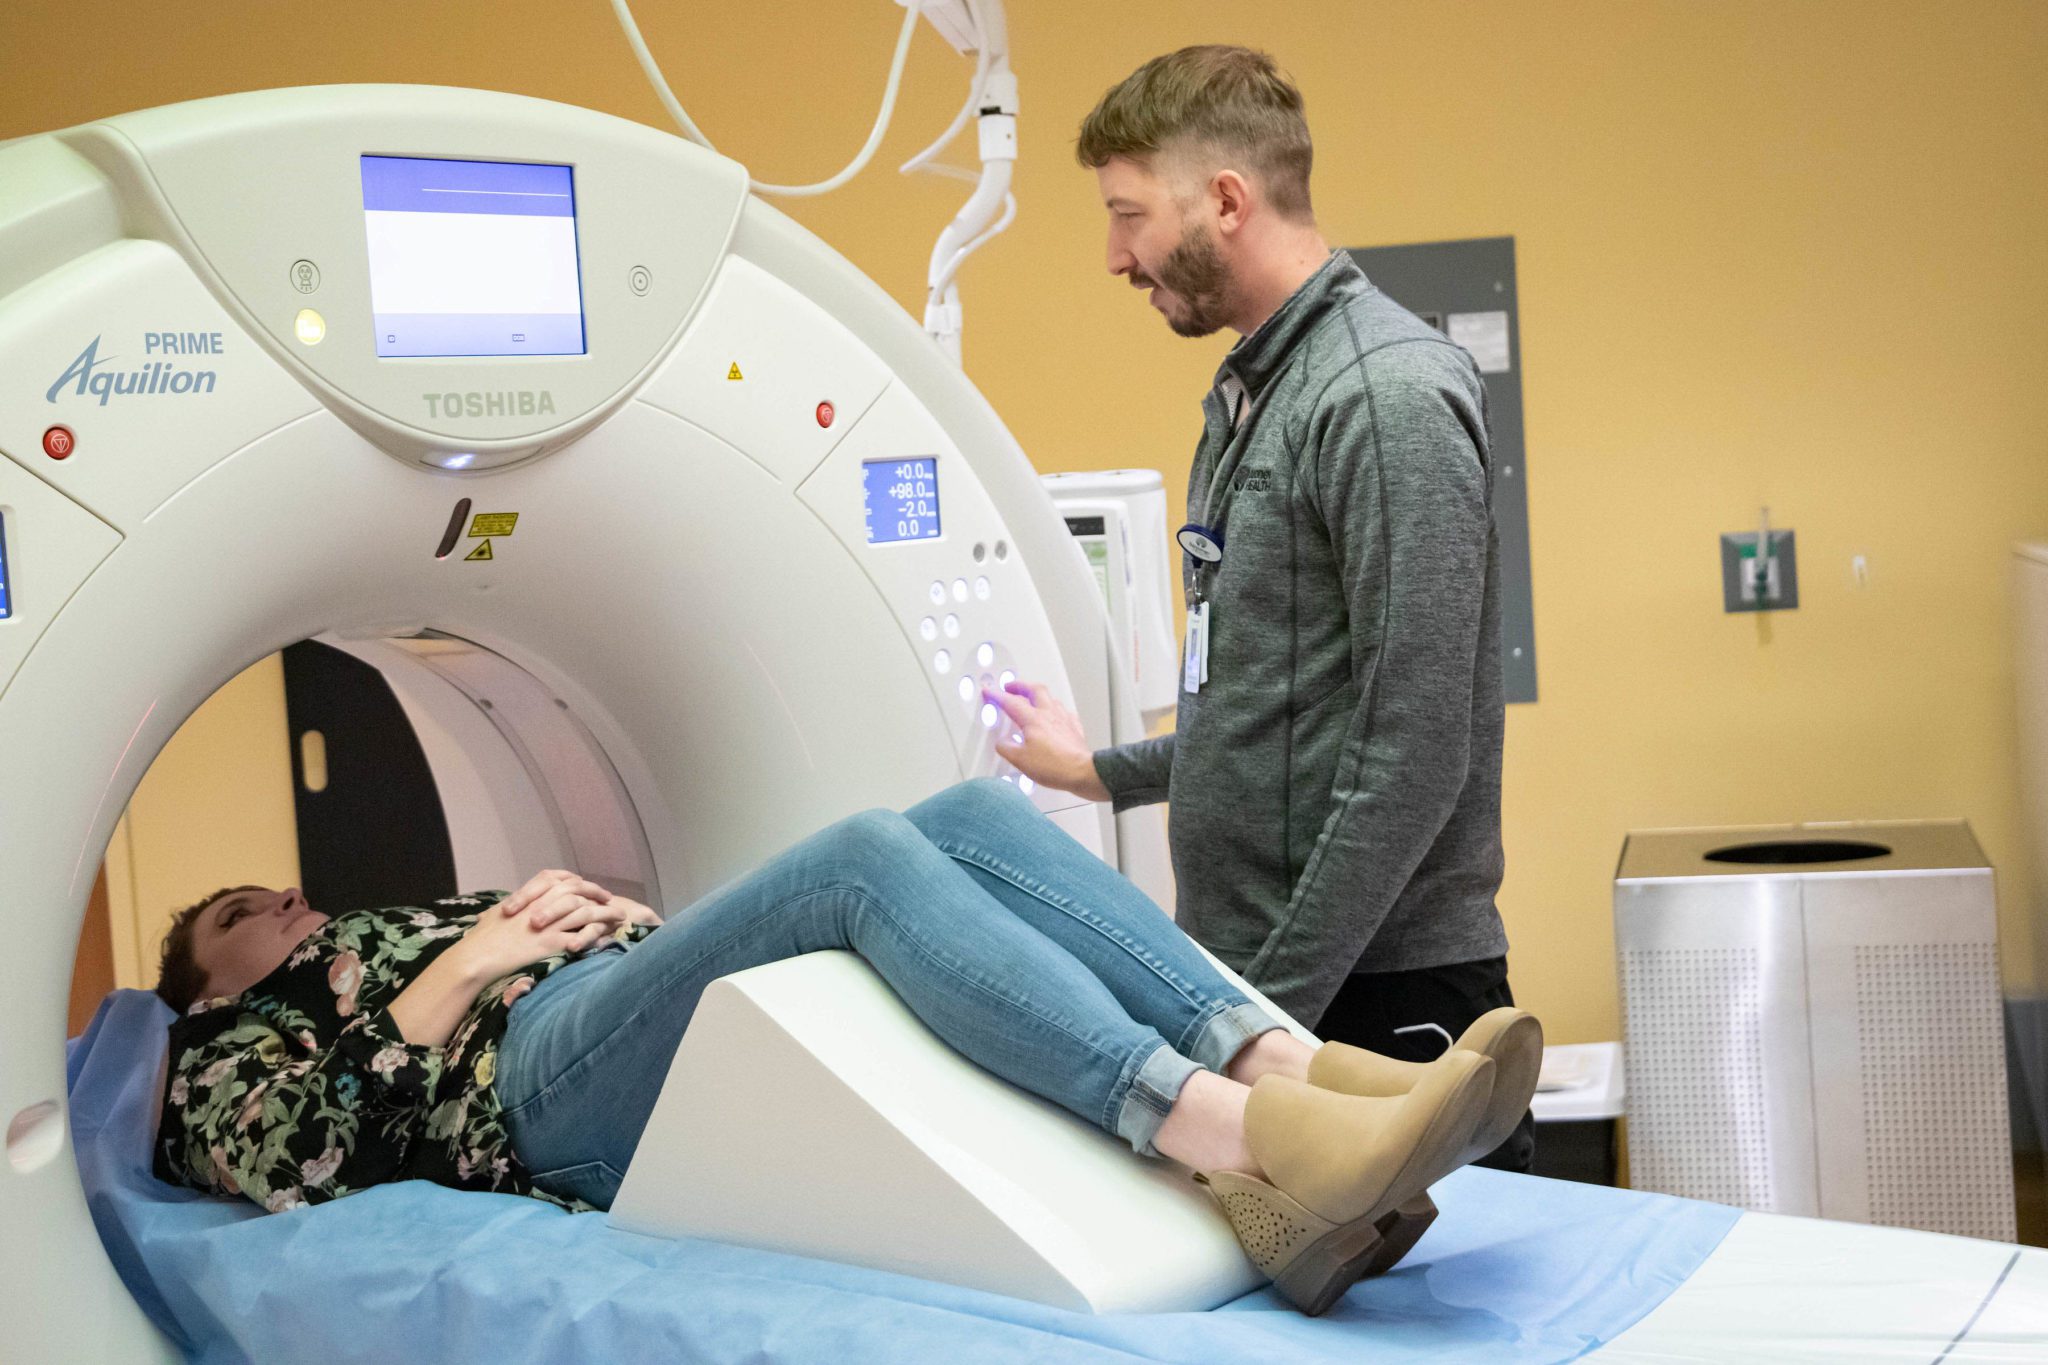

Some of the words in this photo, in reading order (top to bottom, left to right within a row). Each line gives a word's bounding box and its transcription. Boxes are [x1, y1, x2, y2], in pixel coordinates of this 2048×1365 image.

[145, 332, 224, 354] PRIME
[46, 334, 217, 406] Aquilion
[422, 390, 556, 418] TOSHIBA
[889, 481, 925, 499] +98.0
[898, 519, 919, 537] 0.0
